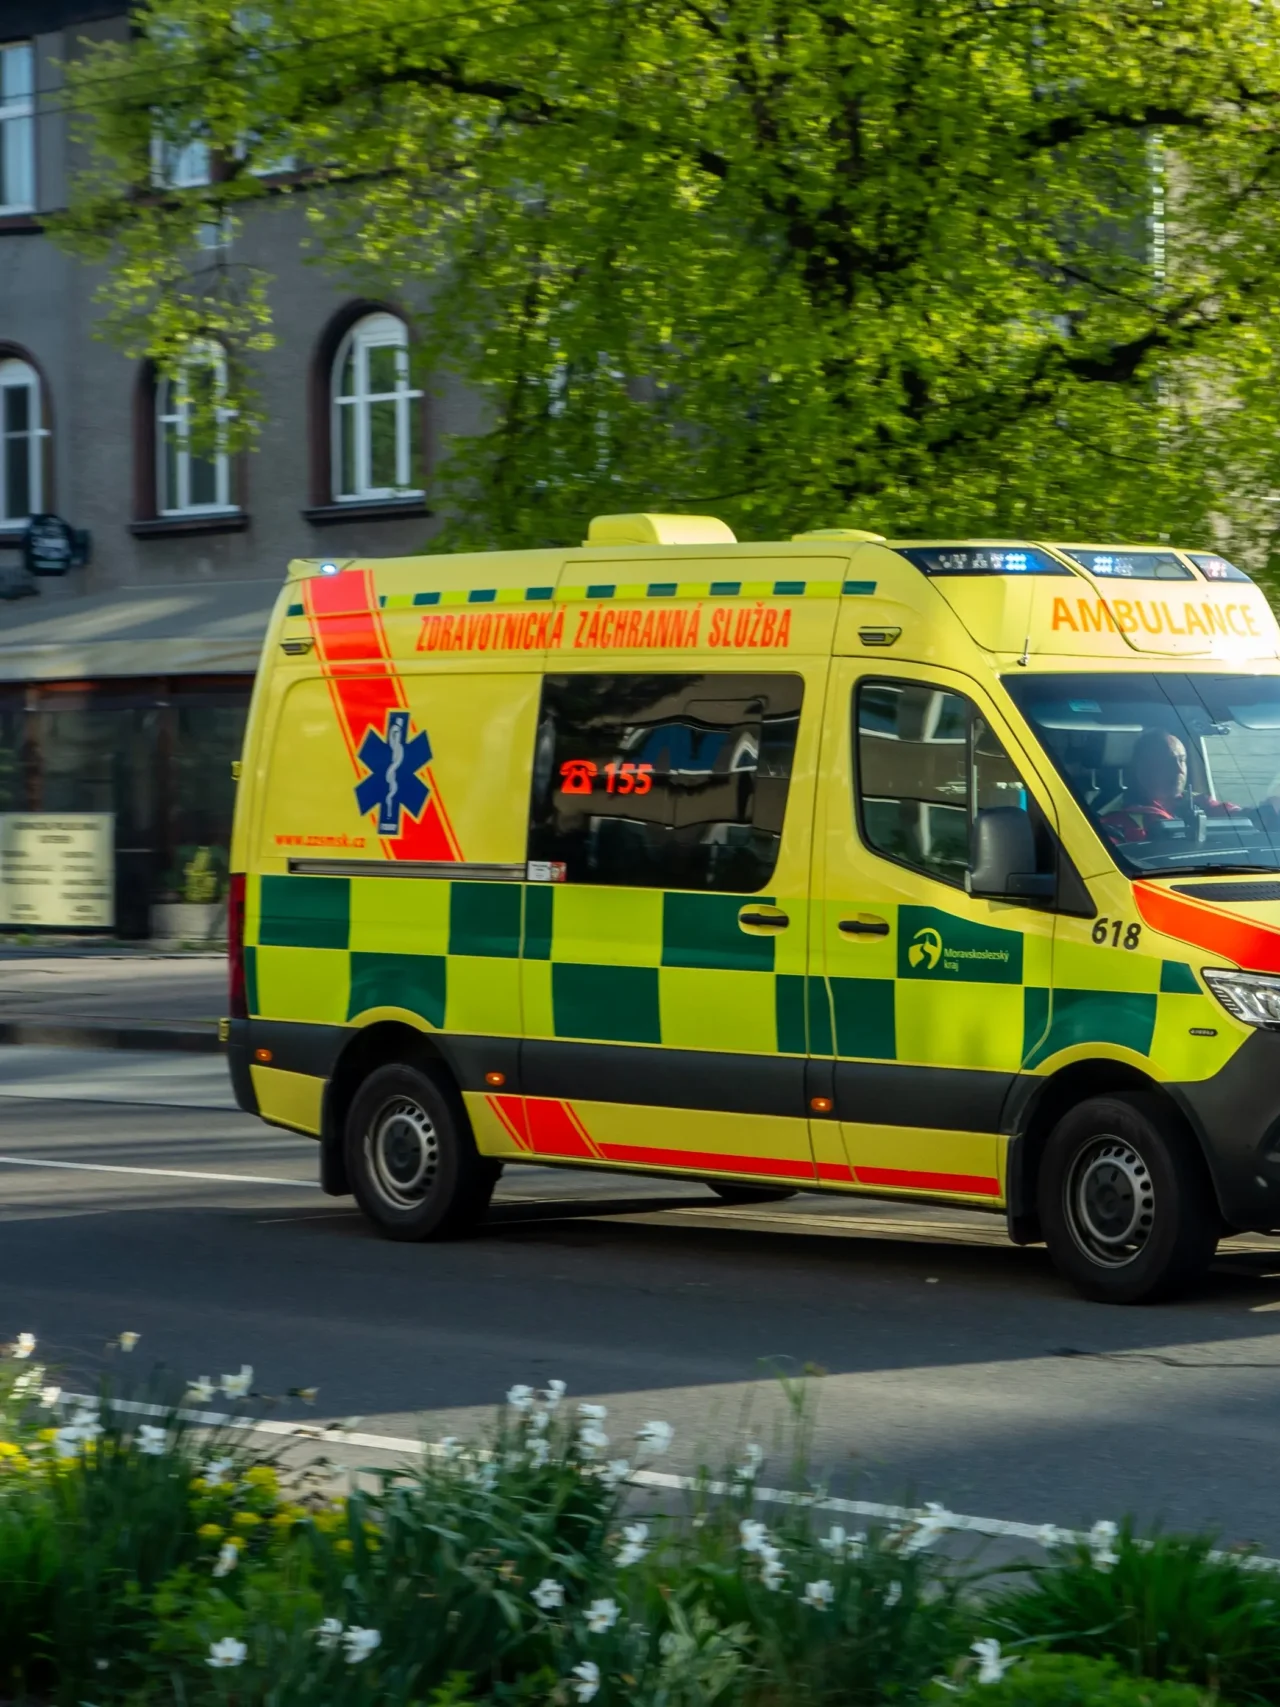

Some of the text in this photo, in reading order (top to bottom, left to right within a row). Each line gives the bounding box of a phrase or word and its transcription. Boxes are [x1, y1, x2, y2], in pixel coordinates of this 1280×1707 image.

[416, 602, 792, 651] ZDRAVOTNICKÁ ZÁCHRANNÁ SLUŽBA
[1051, 597, 1261, 636] AMBULANCE
[604, 763, 653, 794] 155
[1091, 917, 1142, 950] 618
